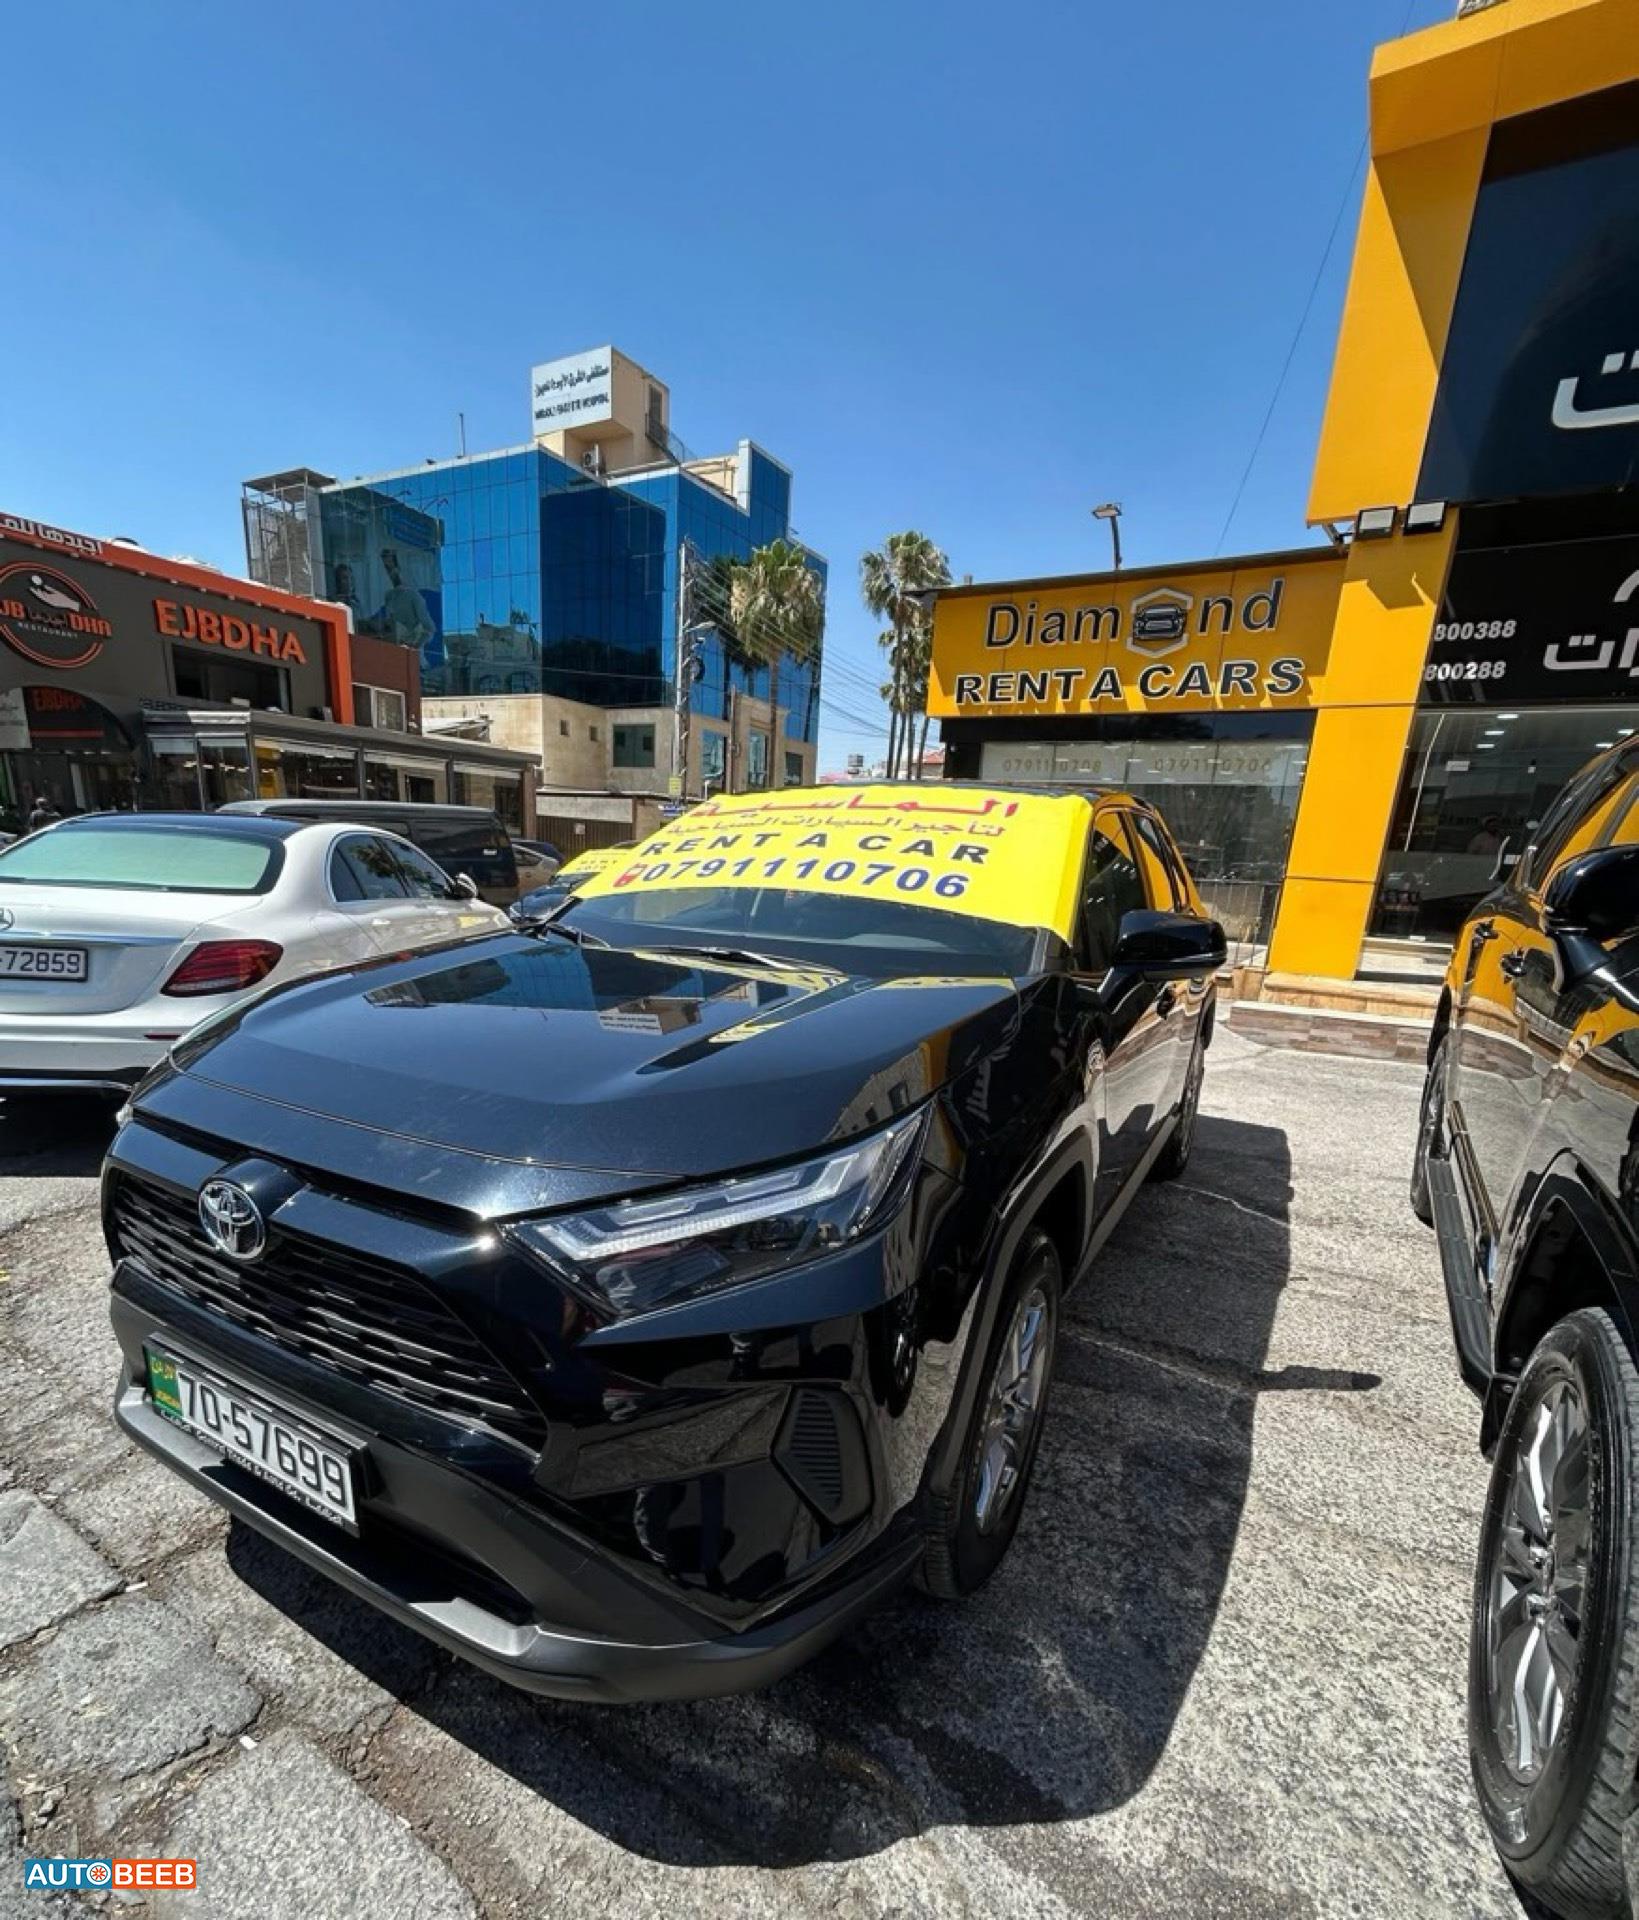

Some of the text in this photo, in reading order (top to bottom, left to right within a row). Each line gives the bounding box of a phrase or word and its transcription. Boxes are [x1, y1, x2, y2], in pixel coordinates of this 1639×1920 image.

[154, 599, 308, 664] EJBDHA
[1434, 619, 1517, 641] 800388
[955, 658, 1306, 706] RENT A CARS
[1424, 660, 1507, 681] 800288
[641, 832, 989, 864] RENT A CAR
[642, 857, 970, 898] 0791110706
[0, 950, 80, 974] -72859
[178, 1372, 348, 1509] 70-57699
